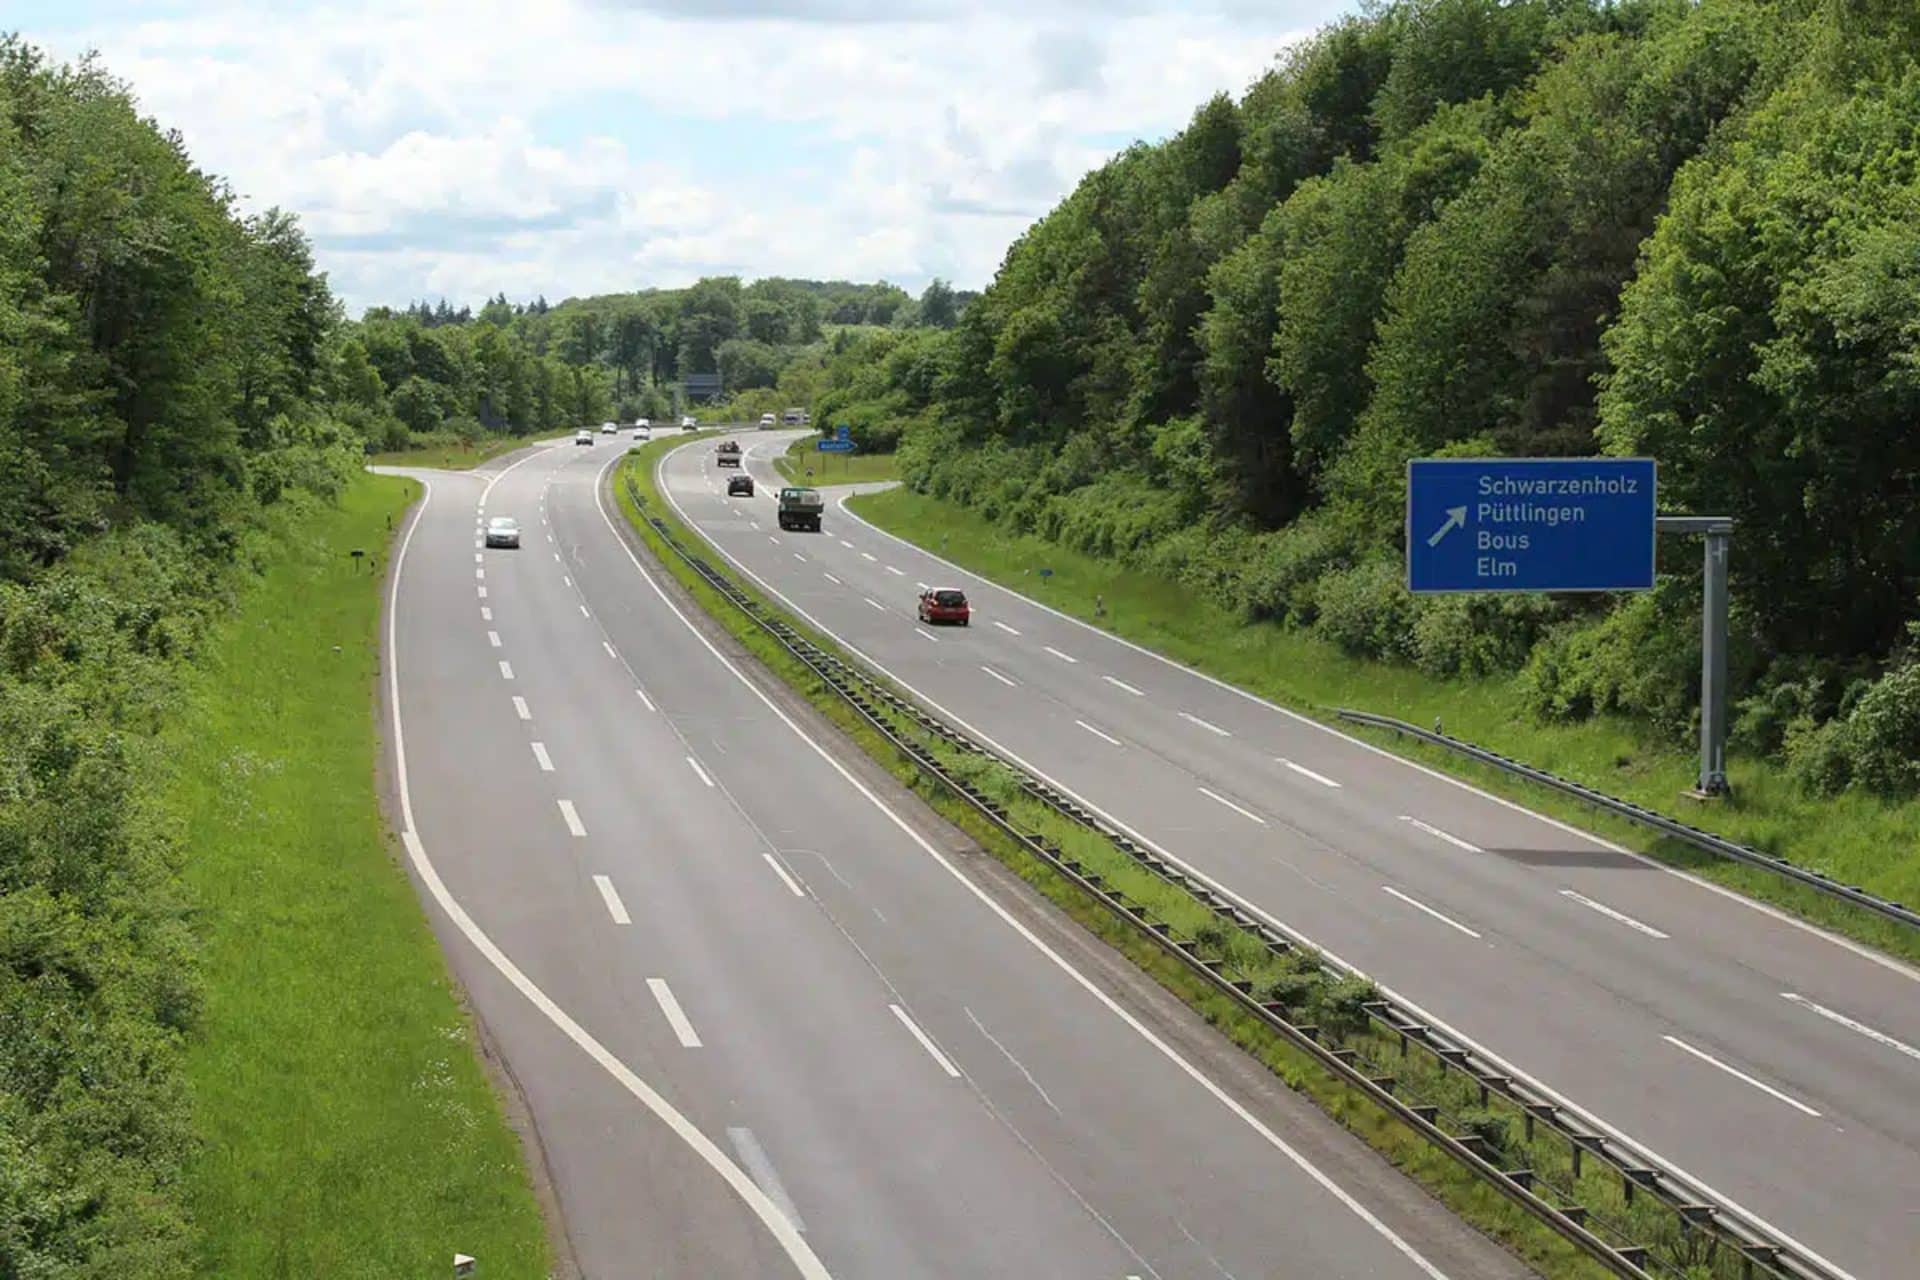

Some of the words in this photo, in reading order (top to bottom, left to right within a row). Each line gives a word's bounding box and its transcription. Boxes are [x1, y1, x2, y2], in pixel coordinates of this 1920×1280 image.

[1478, 475, 1638, 495] Schwarzenholz
[1478, 502, 1585, 526] Püttlingen
[1477, 531, 1530, 550] Bous
[1477, 557, 1517, 577] Elm
